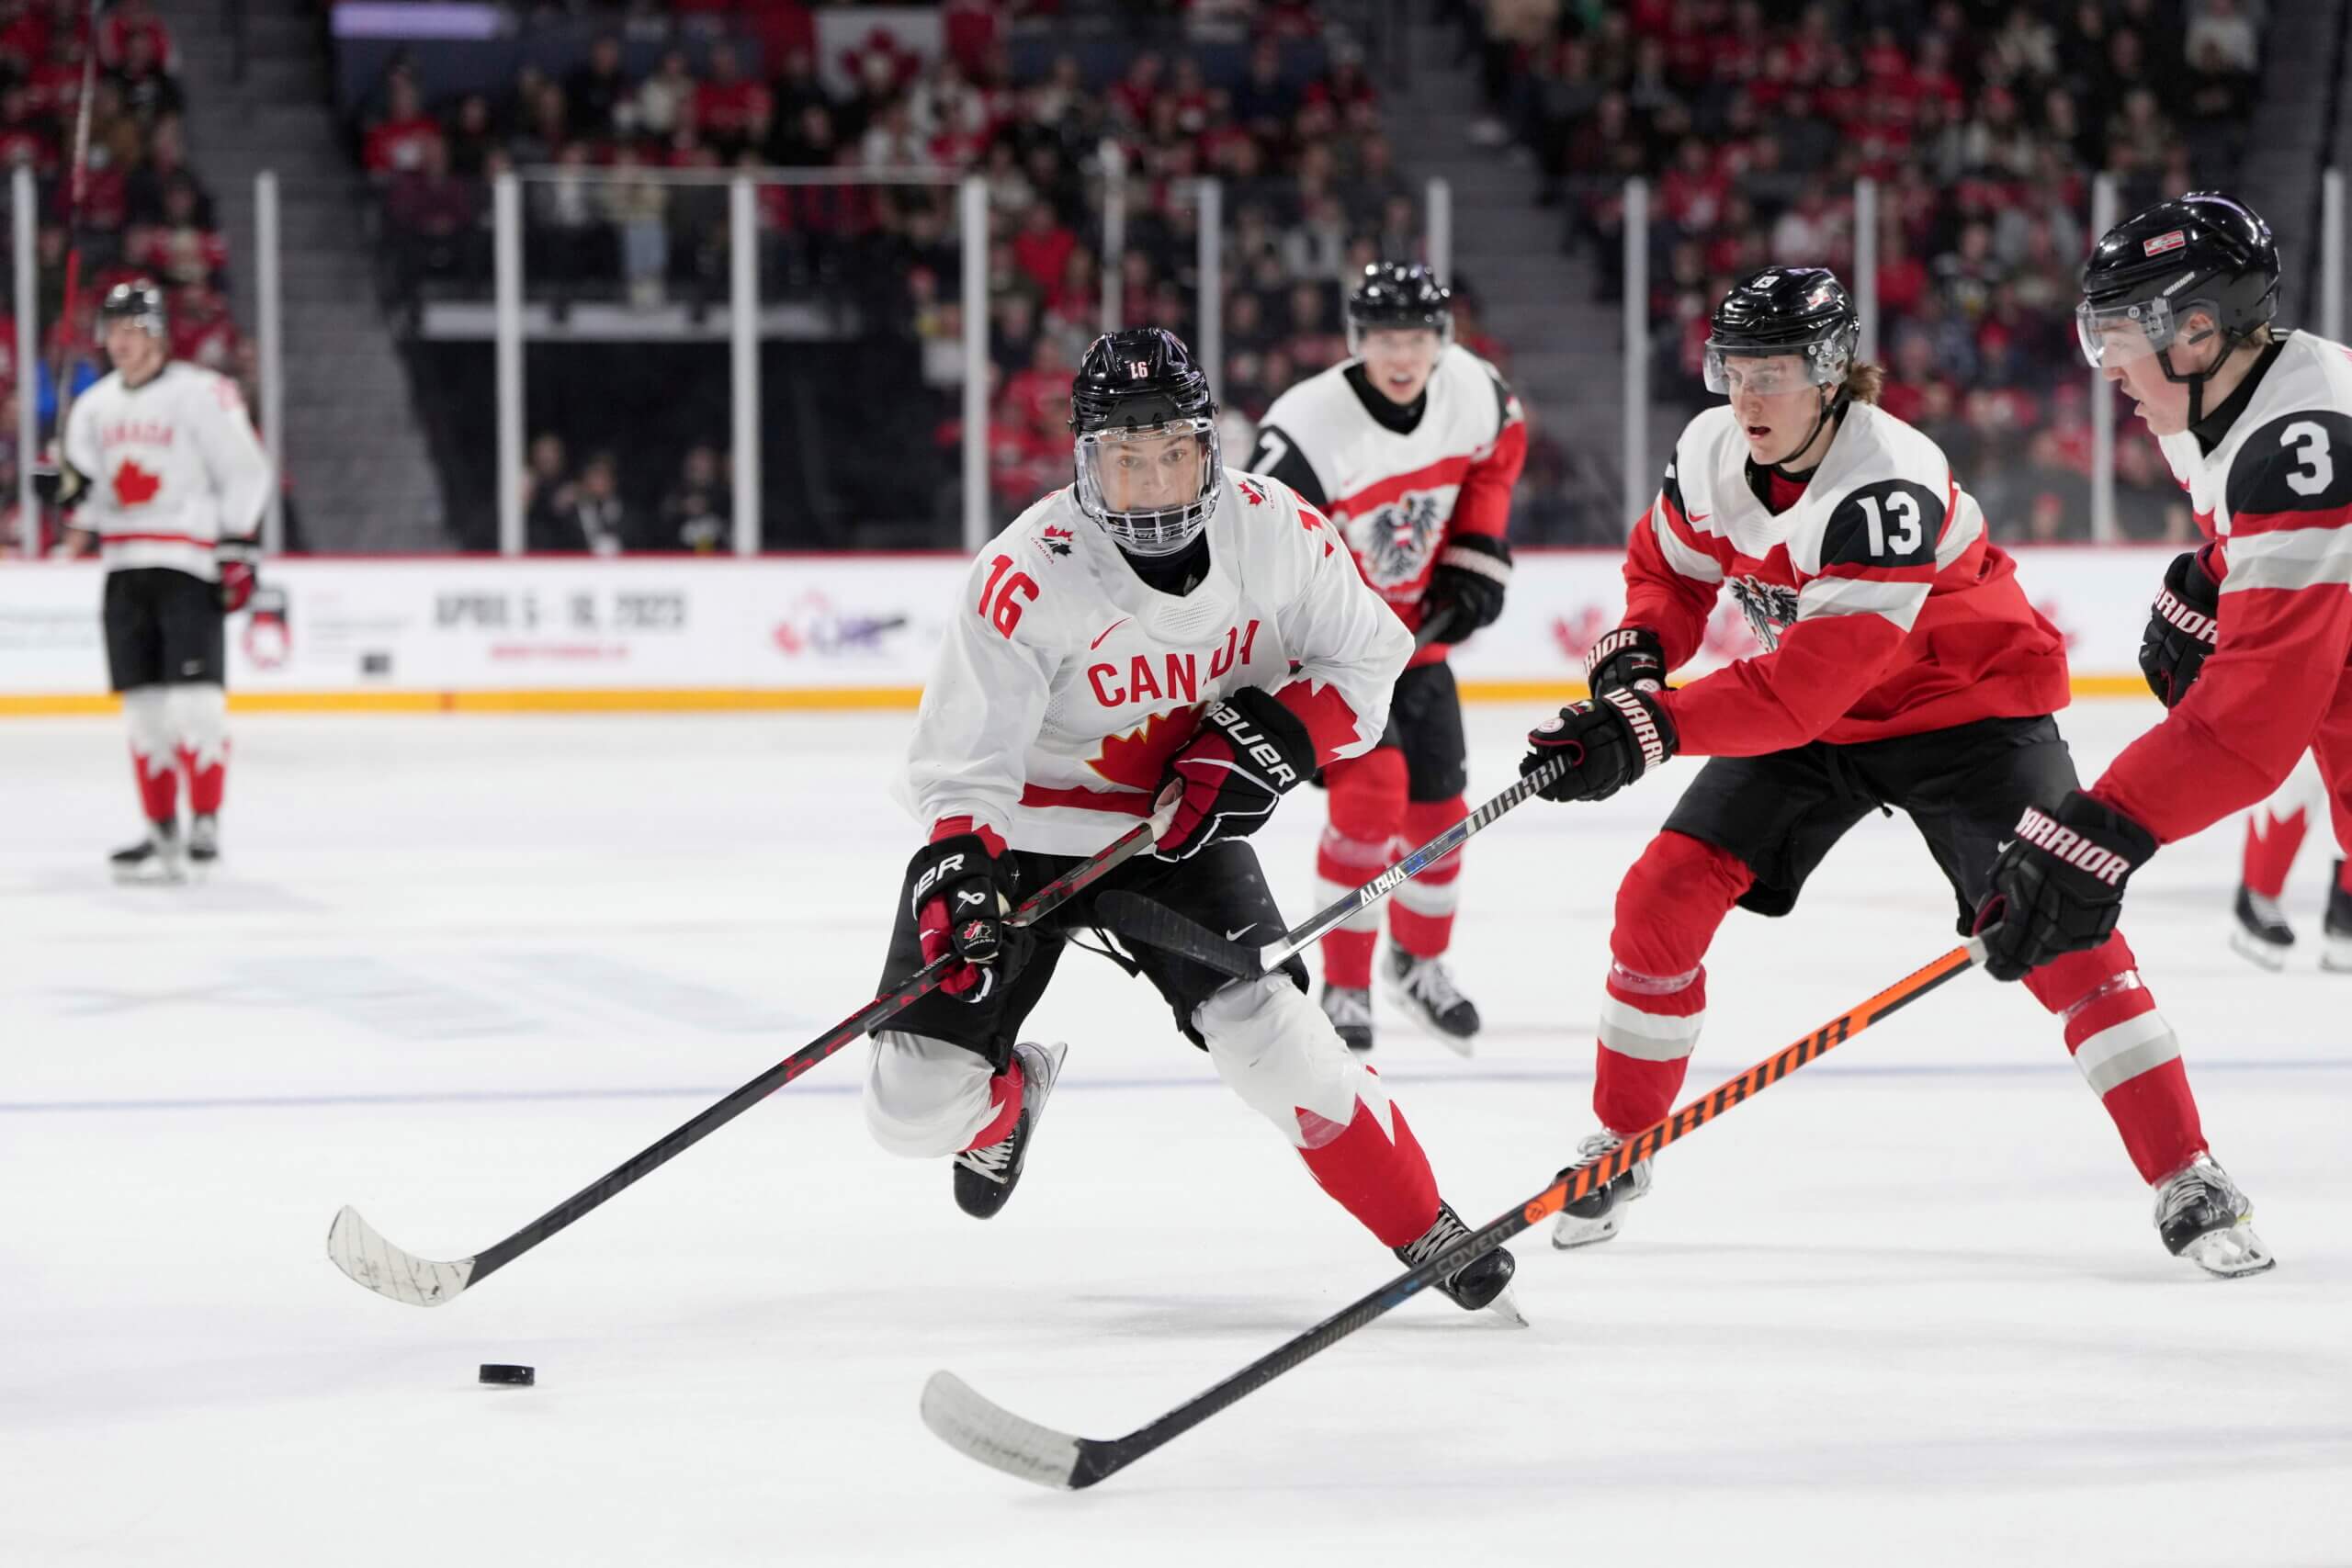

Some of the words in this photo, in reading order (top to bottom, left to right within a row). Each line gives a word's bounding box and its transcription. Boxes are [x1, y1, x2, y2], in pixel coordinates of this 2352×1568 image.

[1130, 361, 1148, 379] 16
[2278, 421, 2335, 497] 3
[1030, 536, 1055, 565] CANADA
[1856, 491, 1922, 558] 13
[978, 554, 1040, 640] 16
[1087, 619, 1260, 708] CANDA
[1584, 629, 1639, 675] RIOR
[1360, 866, 1408, 907] ALPHA
[1564, 1015, 1851, 1205] WARRIOR
[1435, 1218, 1517, 1275] COVERT
